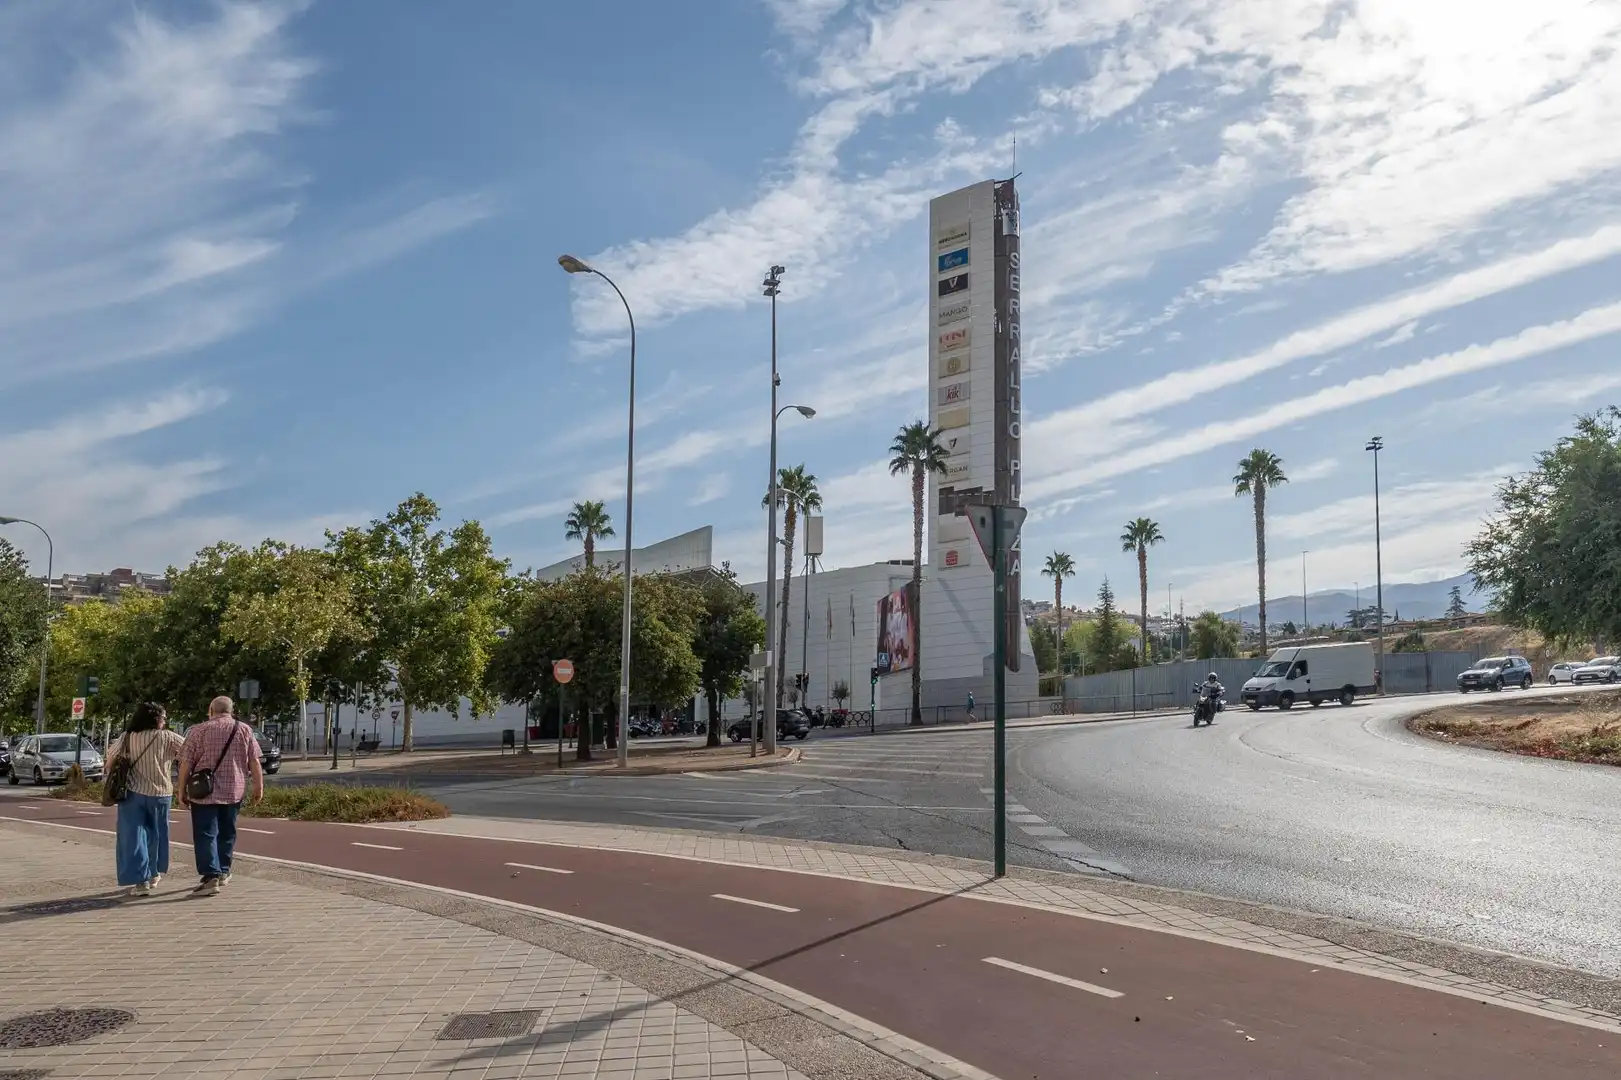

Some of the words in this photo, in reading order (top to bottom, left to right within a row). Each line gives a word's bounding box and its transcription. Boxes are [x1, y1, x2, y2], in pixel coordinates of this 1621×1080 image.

[939, 306, 968, 318] MANGO
[1009, 252, 1020, 438] SERRALLO
[1010, 460, 1020, 576] PLZA
